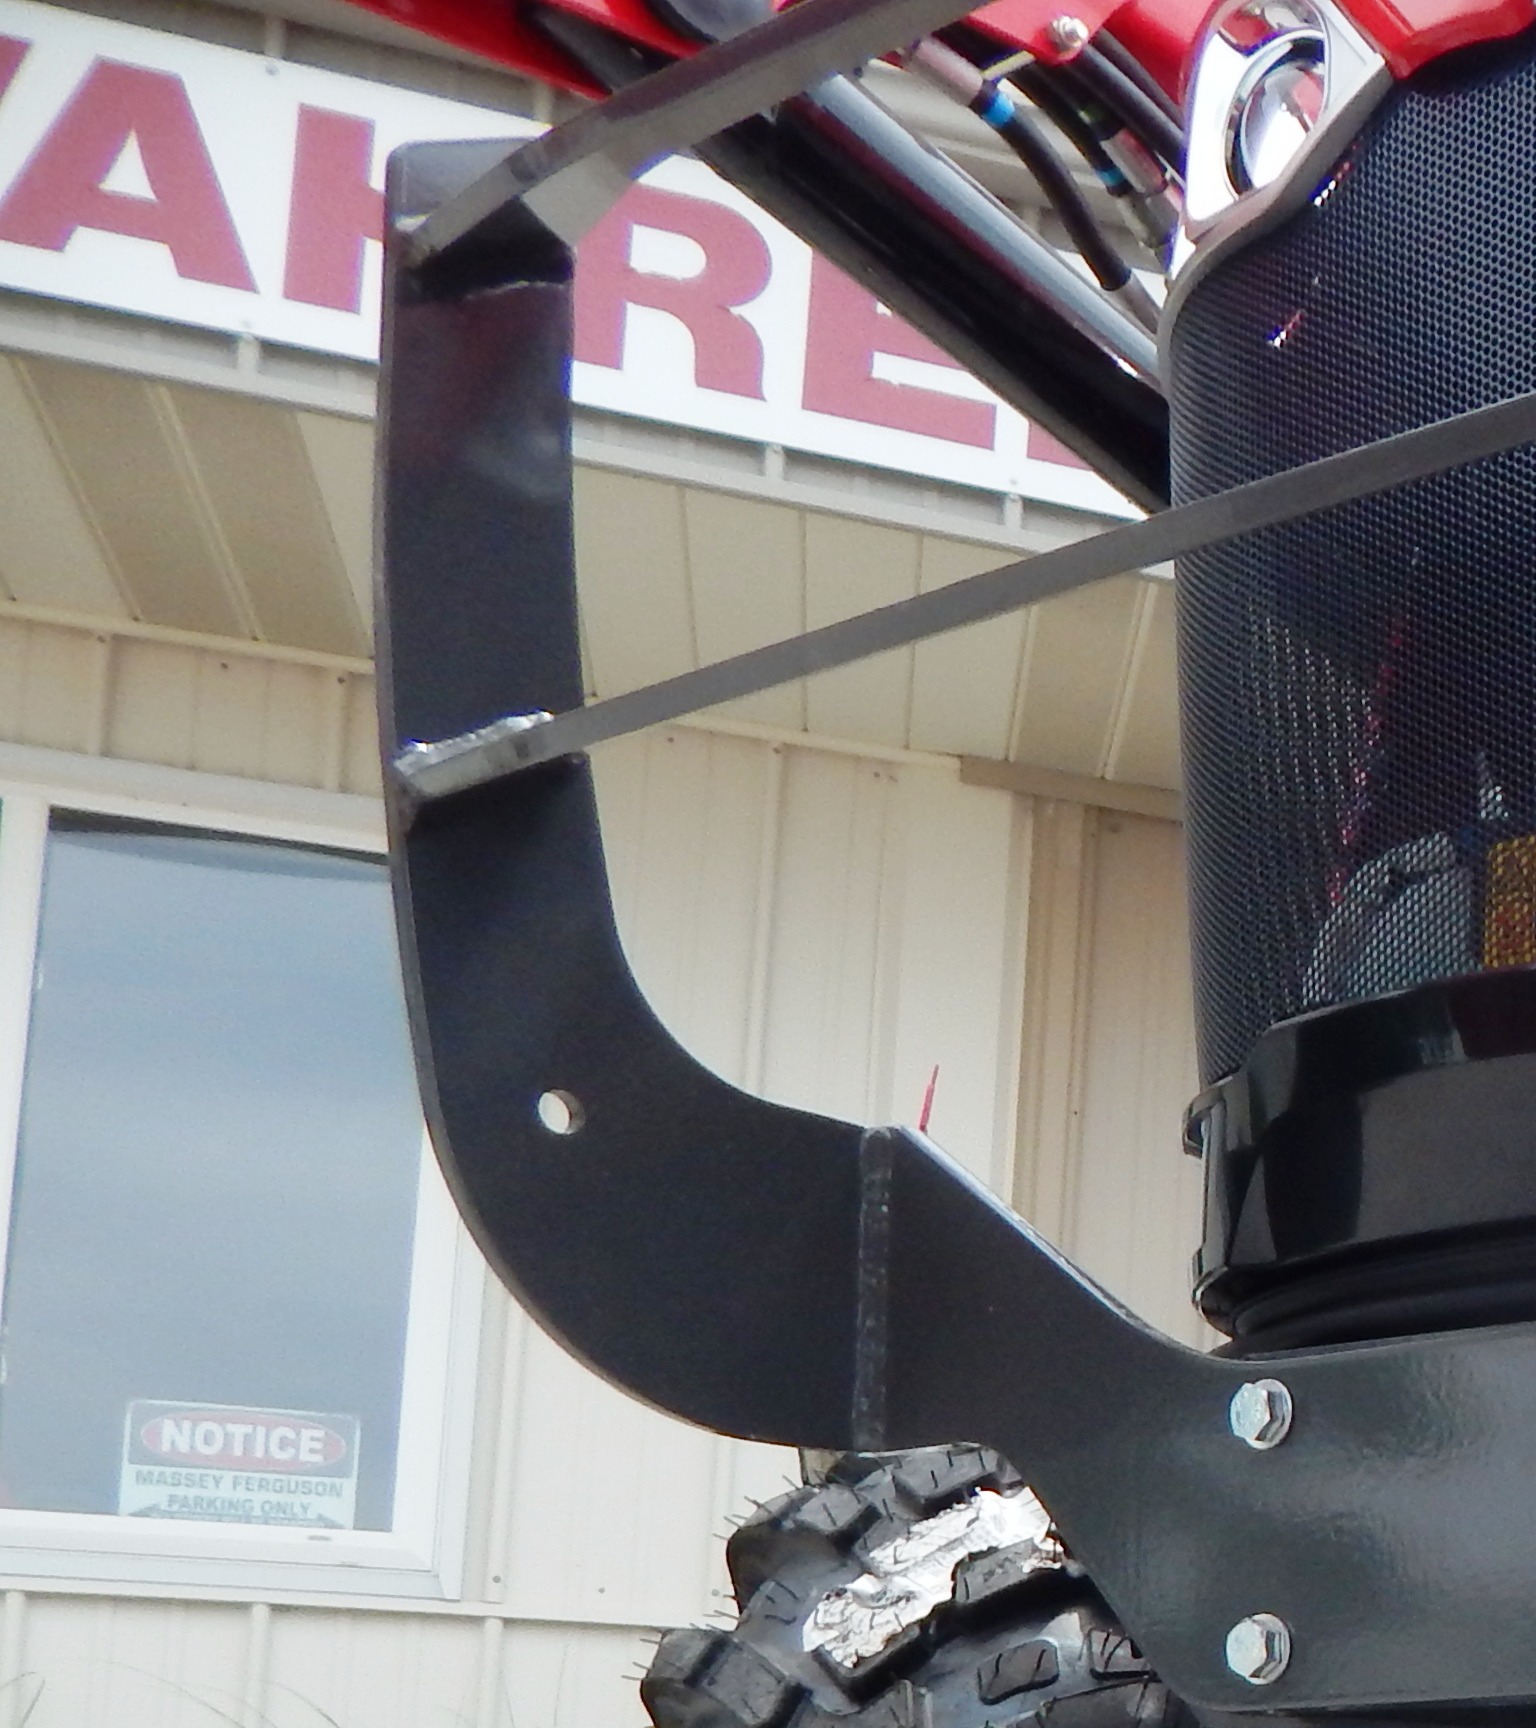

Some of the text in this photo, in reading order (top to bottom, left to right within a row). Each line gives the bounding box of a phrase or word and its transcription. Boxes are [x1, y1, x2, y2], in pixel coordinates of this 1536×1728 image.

[0, 37, 1093, 468] AHRE
[160, 1418, 325, 1463] NOTICE
[135, 1470, 343, 1498] MASSEY FERGUSON
[167, 1494, 311, 1517] PARKING ONLY
